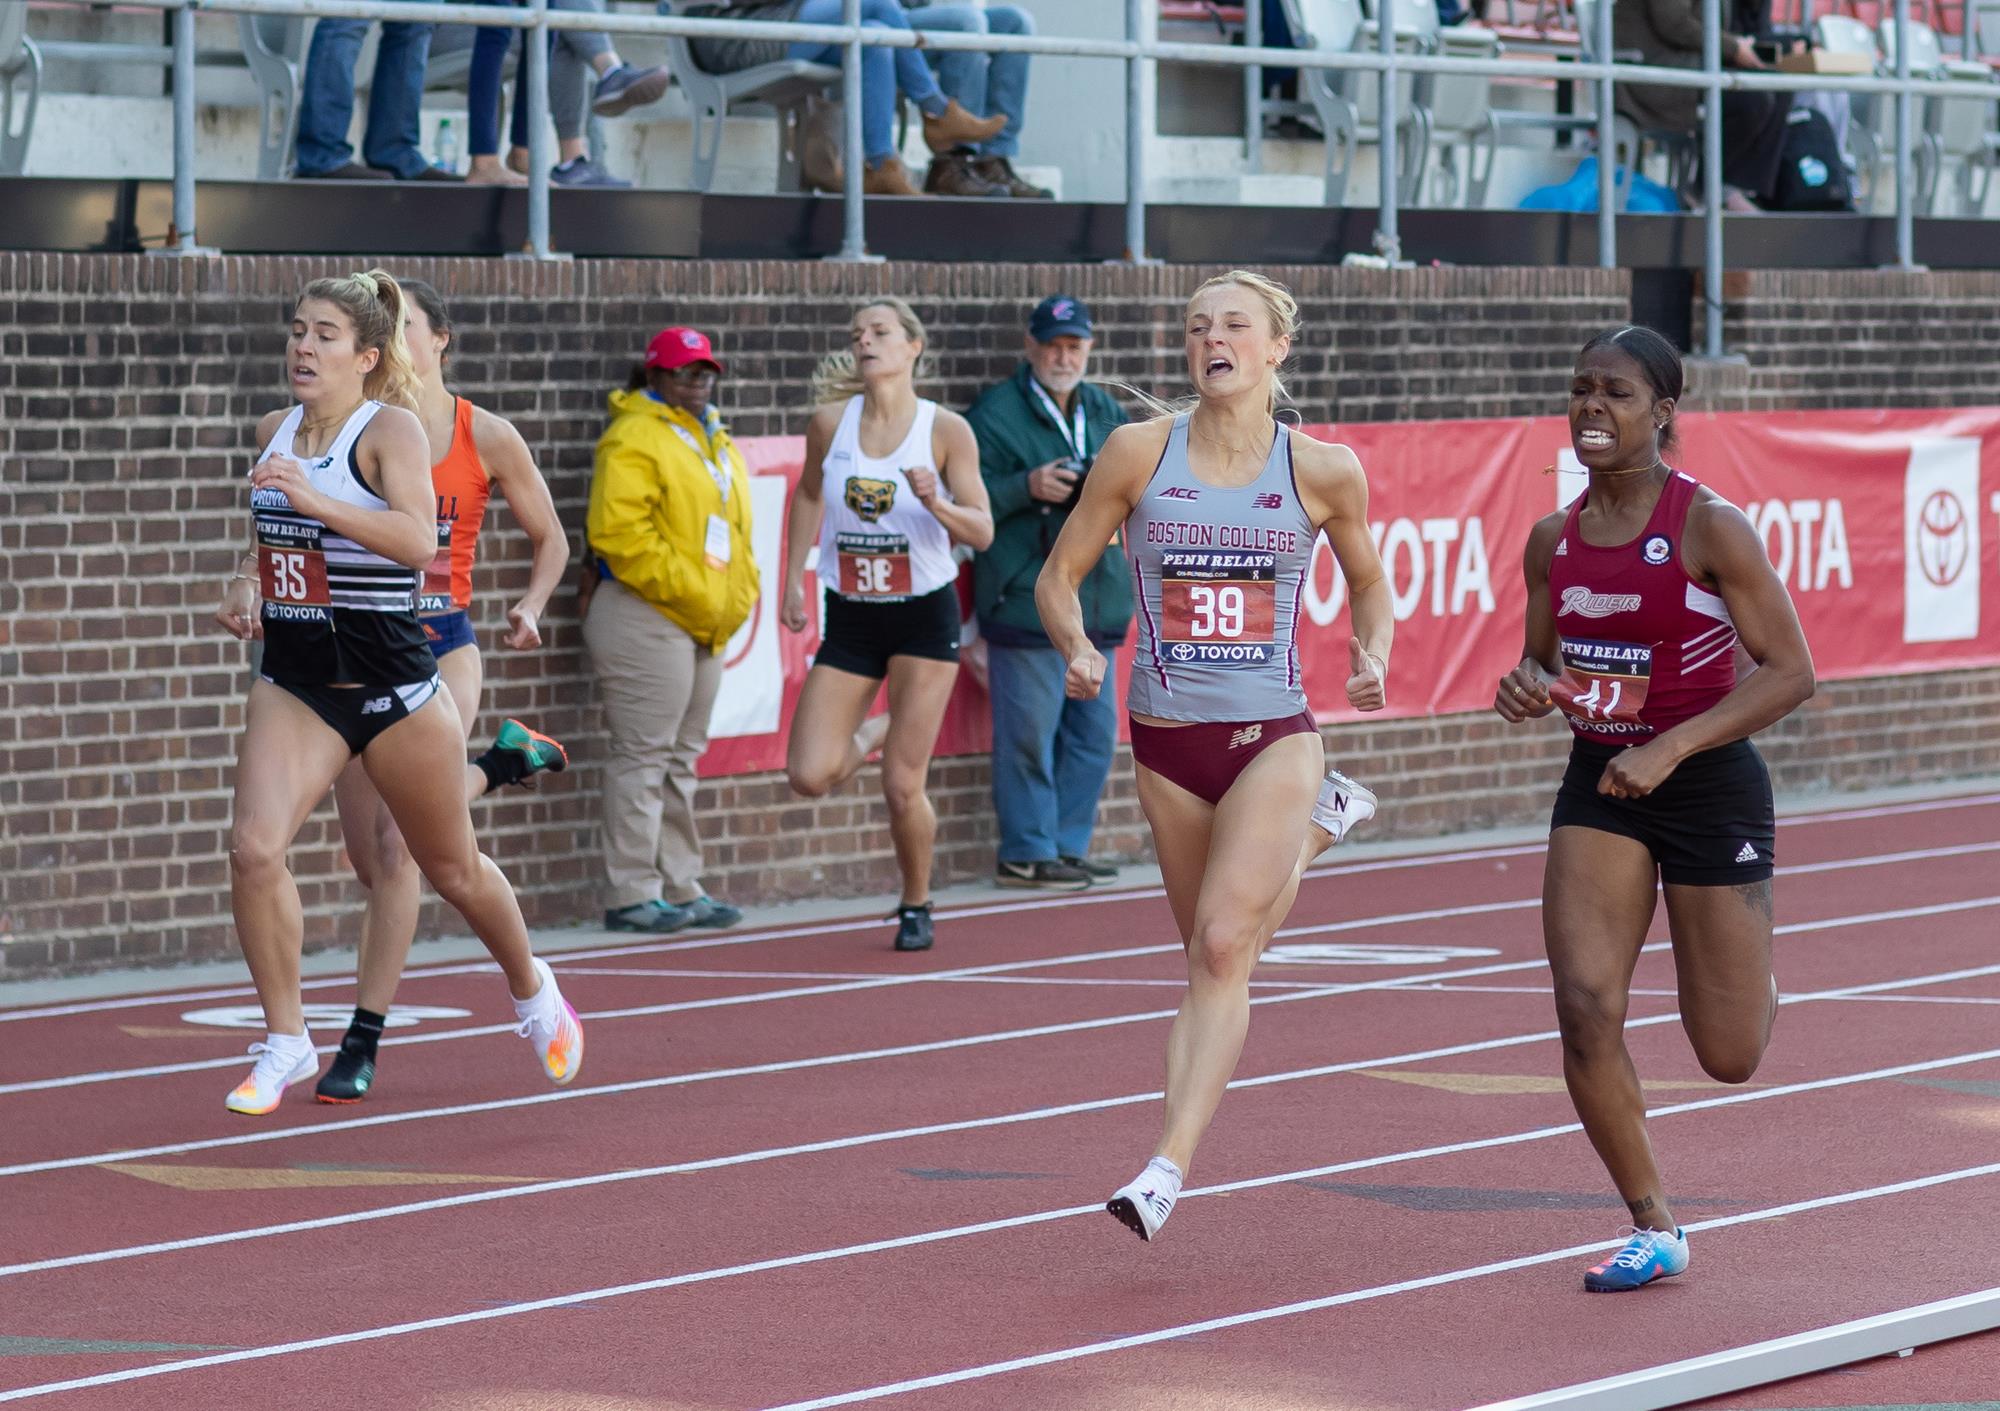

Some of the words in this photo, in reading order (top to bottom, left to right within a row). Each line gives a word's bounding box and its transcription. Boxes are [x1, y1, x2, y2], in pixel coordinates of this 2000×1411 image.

[1158, 487, 1200, 500] ACC
[280, 525, 319, 539] RELAYS
[1147, 521, 1214, 547] BOSTON
[1219, 526, 1297, 553] COLLEGE
[1745, 498, 1853, 592] OTA
[1162, 554, 1210, 566] PENN
[1210, 555, 1274, 567] RELAYS
[271, 552, 307, 600] 35
[278, 605, 326, 620] TOYOTA
[418, 597, 443, 610] OTA
[1191, 586, 1244, 638] 39
[1200, 646, 1265, 660] TOYOTA
[1561, 641, 1592, 657] PENN
[1593, 646, 1651, 661] RELAYS
[1573, 679, 1621, 720] 41
[1334, 791, 1348, 813] N
